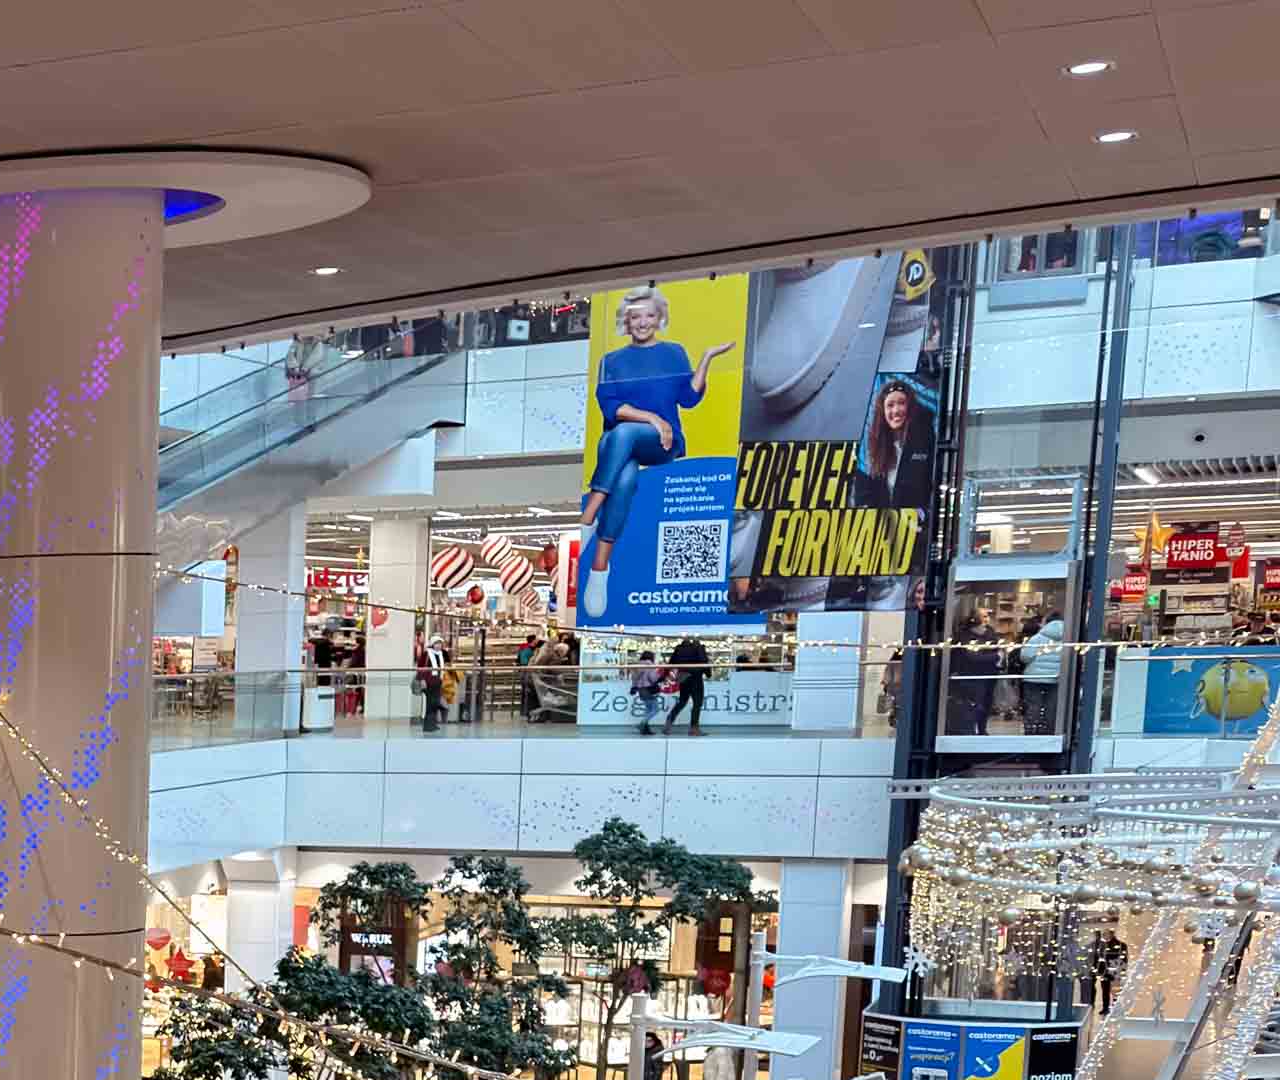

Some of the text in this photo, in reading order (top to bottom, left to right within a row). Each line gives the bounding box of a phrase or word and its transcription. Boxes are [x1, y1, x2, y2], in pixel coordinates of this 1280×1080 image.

[761, 508, 919, 577] FORWARD
[1171, 538, 1215, 550] HIPER
[1171, 550, 1215, 562] TANIO
[968, 1032, 1016, 1041] castorama
